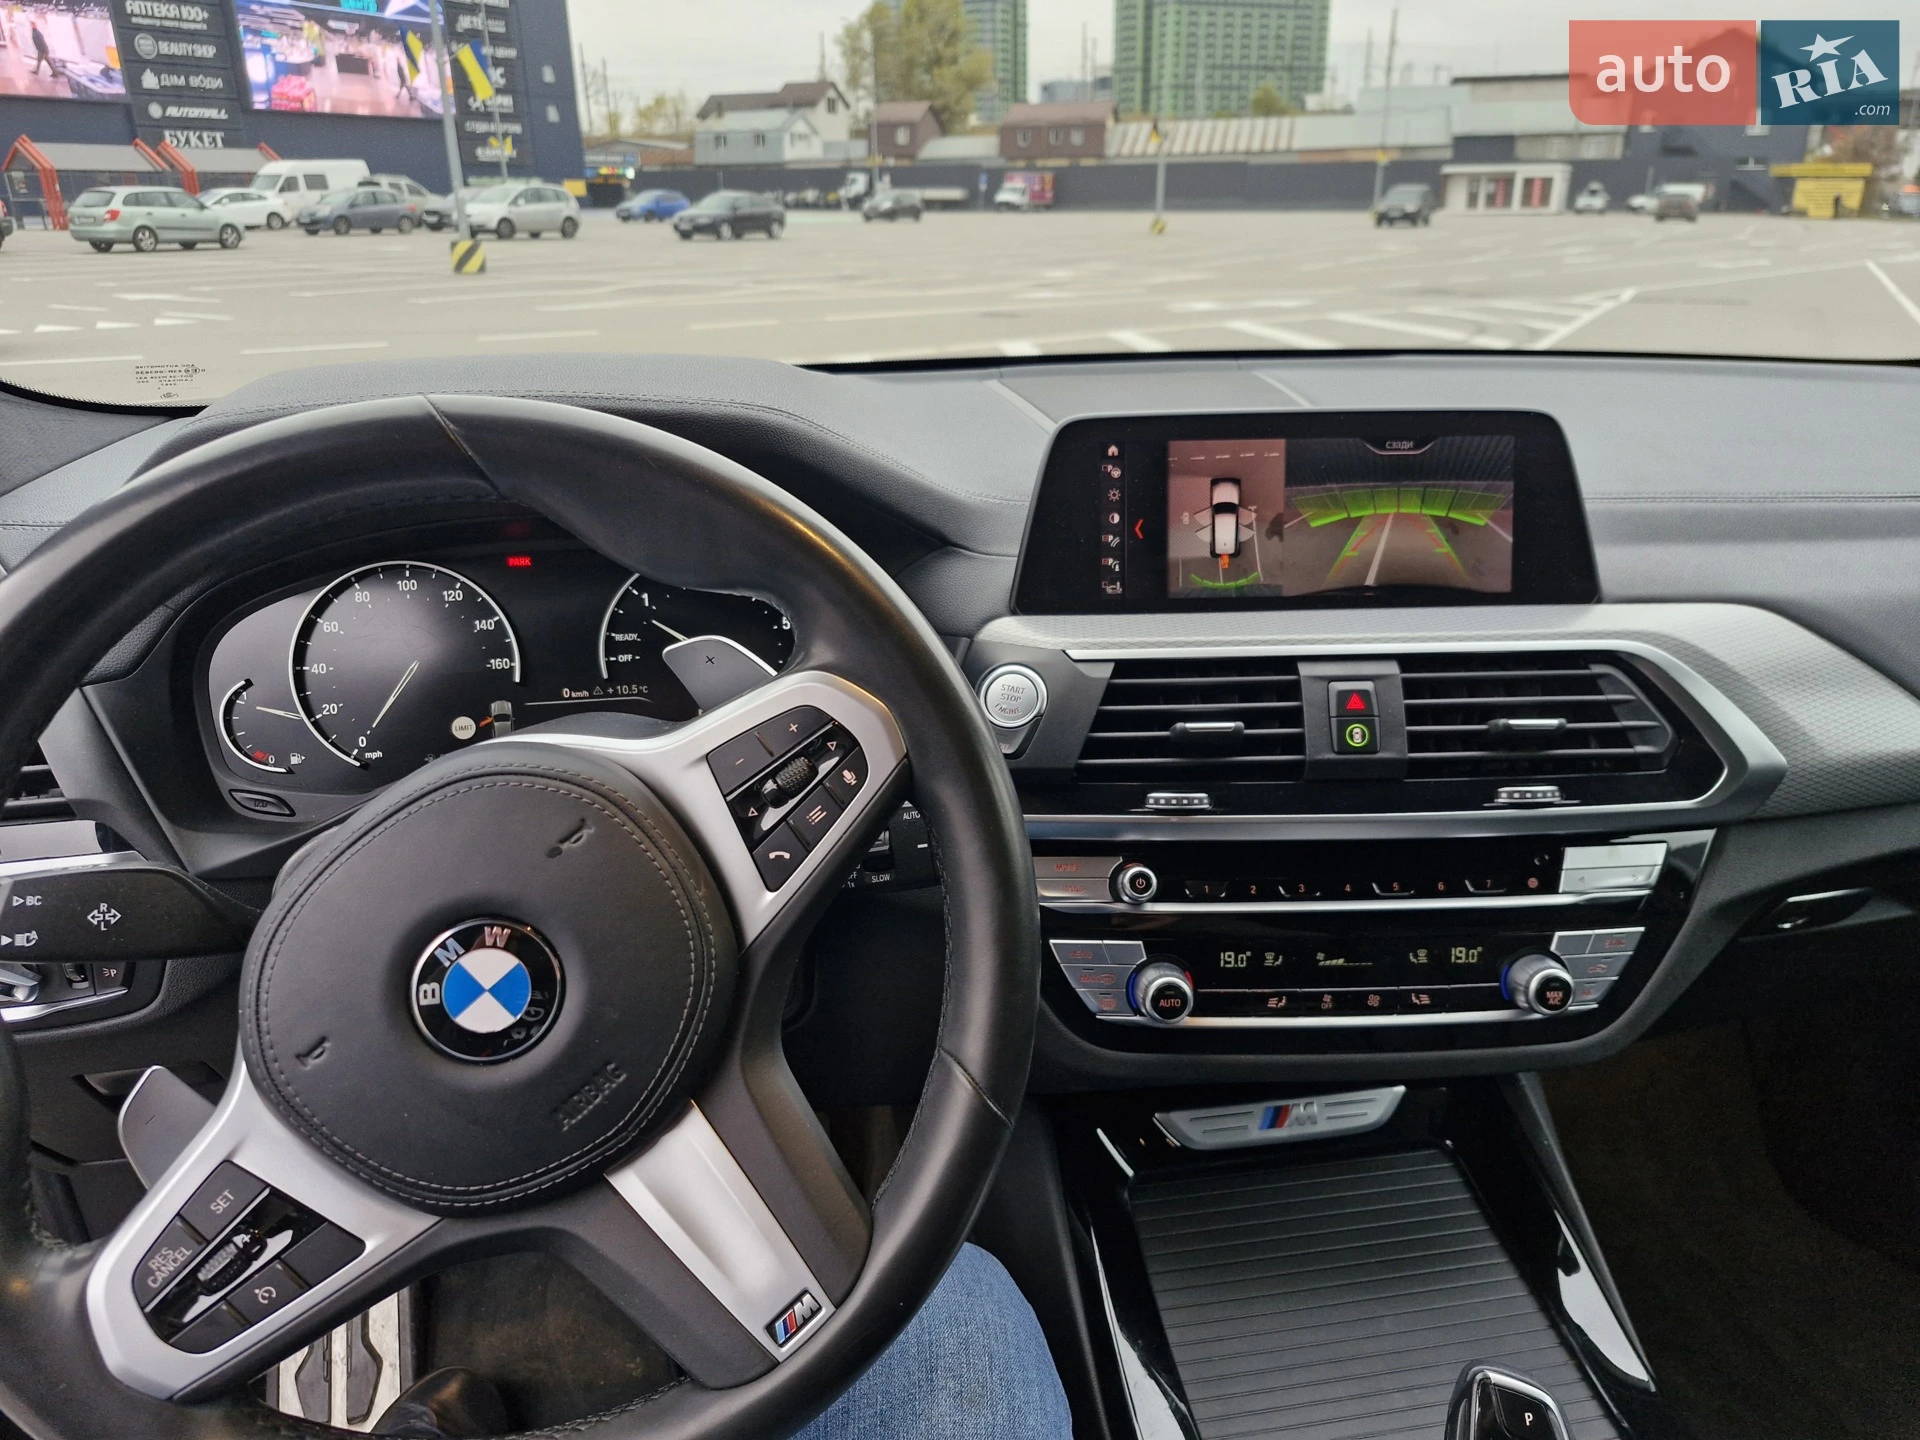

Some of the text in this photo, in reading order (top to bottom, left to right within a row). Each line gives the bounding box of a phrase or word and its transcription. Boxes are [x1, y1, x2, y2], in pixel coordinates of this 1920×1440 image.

[125, 0, 209, 21] АПТЕКА 100+
[158, 40, 192, 56] BEAUTY
[193, 43, 216, 58] SHOP
[165, 106, 229, 119] AUTOMALL
[163, 130, 225, 149] БУКЕТ
[507, 557, 532, 567] PARK
[396, 580, 418, 591] 100
[355, 591, 370, 603] 80
[442, 590, 463, 602] 120
[641, 592, 649, 607] 1
[323, 621, 339, 633] 60
[474, 619, 495, 631] 140
[782, 616, 791, 630] 5
[615, 633, 638, 641] READY
[490, 658, 510, 670] 160
[618, 654, 633, 662] OFF
[311, 663, 326, 674] 40
[563, 688, 570, 698] 0
[571, 690, 589, 698] km/h
[1001, 684, 1026, 694] START
[1000, 694, 1022, 703] STOP
[322, 704, 338, 715] 20
[995, 703, 1022, 715] ENGINE
[358, 736, 367, 748] 0
[268, 755, 275, 764] 0
[365, 750, 383, 760] mph
[903, 811, 921, 820] AUTO
[871, 874, 891, 883] SLOW
[1204, 880, 1492, 894] 1 2 3 4 5 6 7
[26, 896, 42, 906] BC
[101, 903, 107, 912] R
[101, 922, 107, 931] L
[419, 926, 511, 1006] BMW
[1546, 991, 1563, 999] MAX
[1159, 999, 1181, 1007] AUTO
[210, 1189, 235, 1214] SET
[148, 1247, 174, 1271] RES
[147, 1247, 193, 1289] CANCEL
[1524, 1412, 1533, 1426] P
